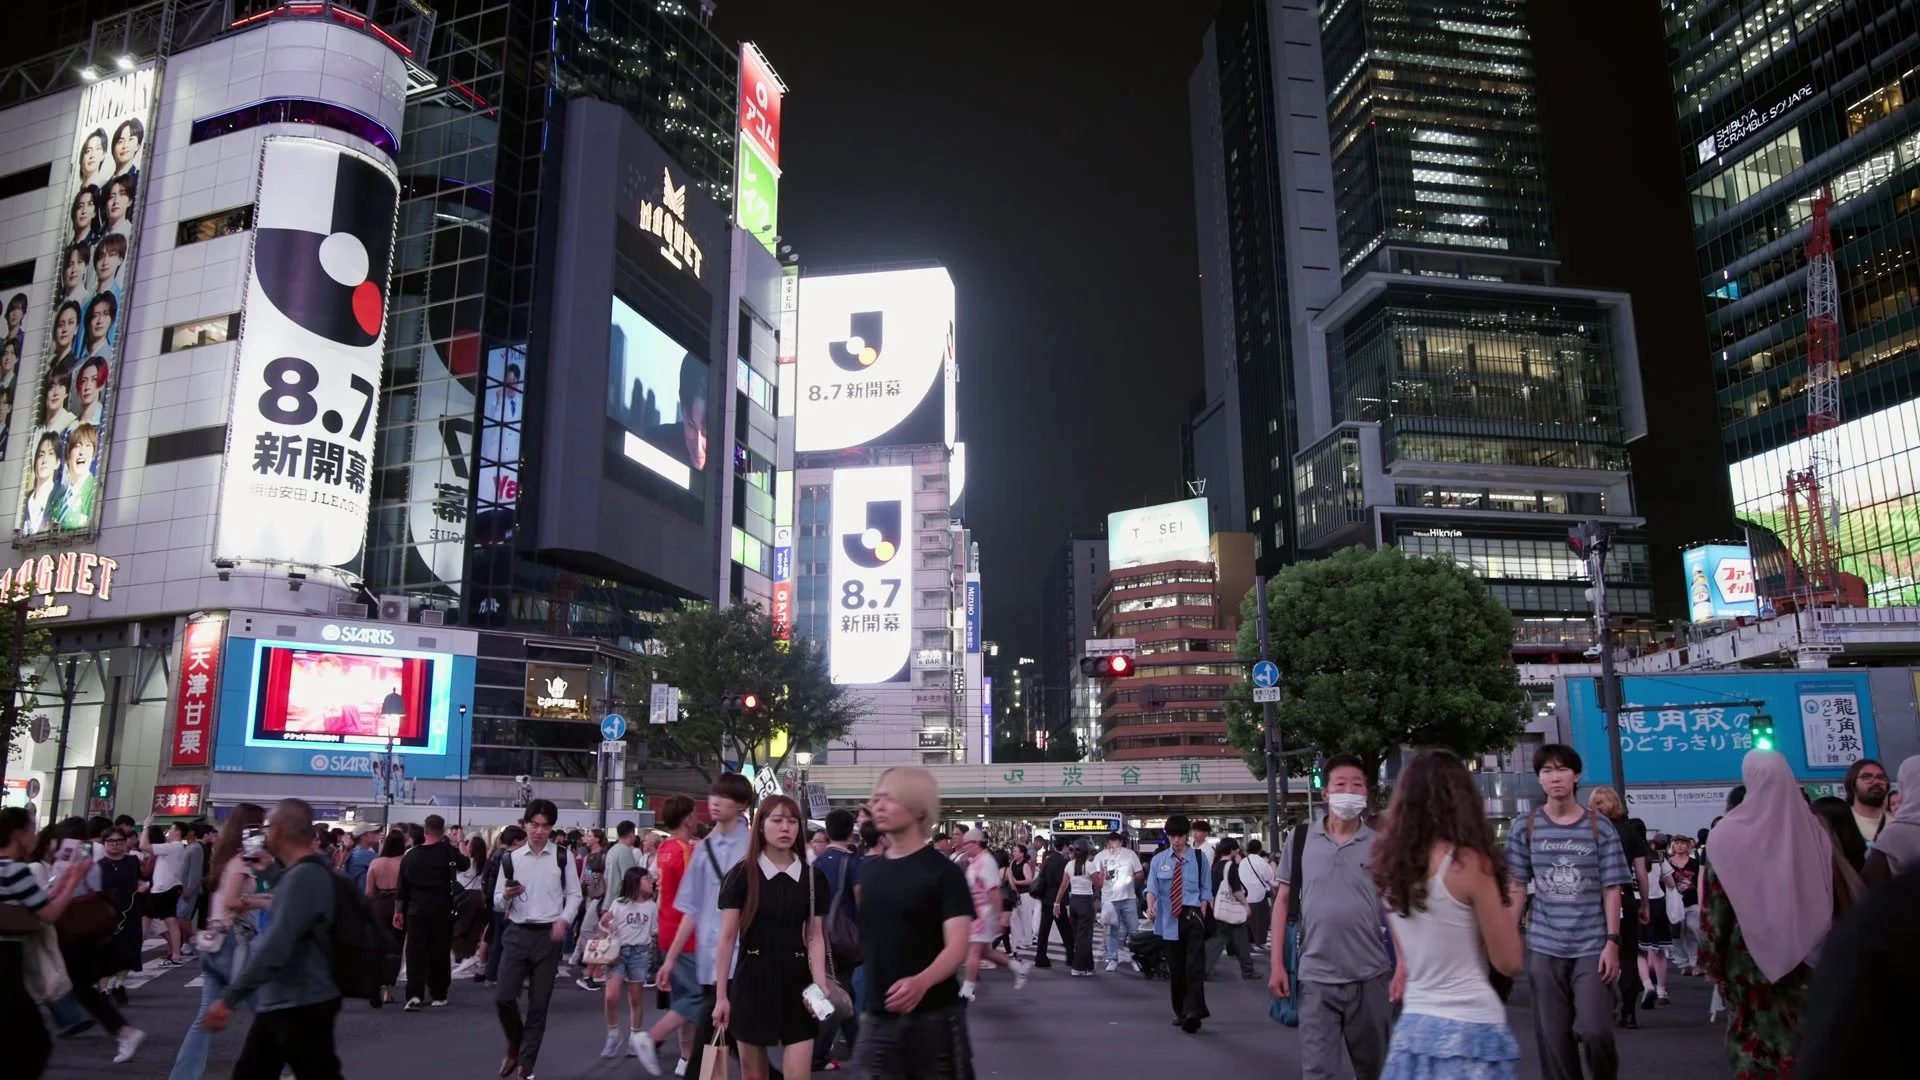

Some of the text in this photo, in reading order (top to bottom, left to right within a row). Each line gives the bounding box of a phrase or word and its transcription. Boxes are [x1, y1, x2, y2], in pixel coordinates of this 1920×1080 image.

[745, 96, 776, 152] アコム
[1716, 109, 1758, 141] SHIBUYA
[1717, 83, 1813, 151] SCRAMBLE SQUARE
[258, 356, 375, 443] 8.7
[808, 379, 902, 402] 8.7 新開幕
[252, 431, 367, 494] 新開幕
[1430, 528, 1463, 538] Hikarie
[841, 578, 902, 610] 8.7
[841, 613, 901, 633] 新開幕
[179, 647, 211, 755] 天津甘栗
[1004, 763, 1201, 786] JR 渋谷駅
[154, 793, 199, 808] 天津甘栗
[1815, 785, 1831, 795] JR
[626, 912, 649, 925] GAP
